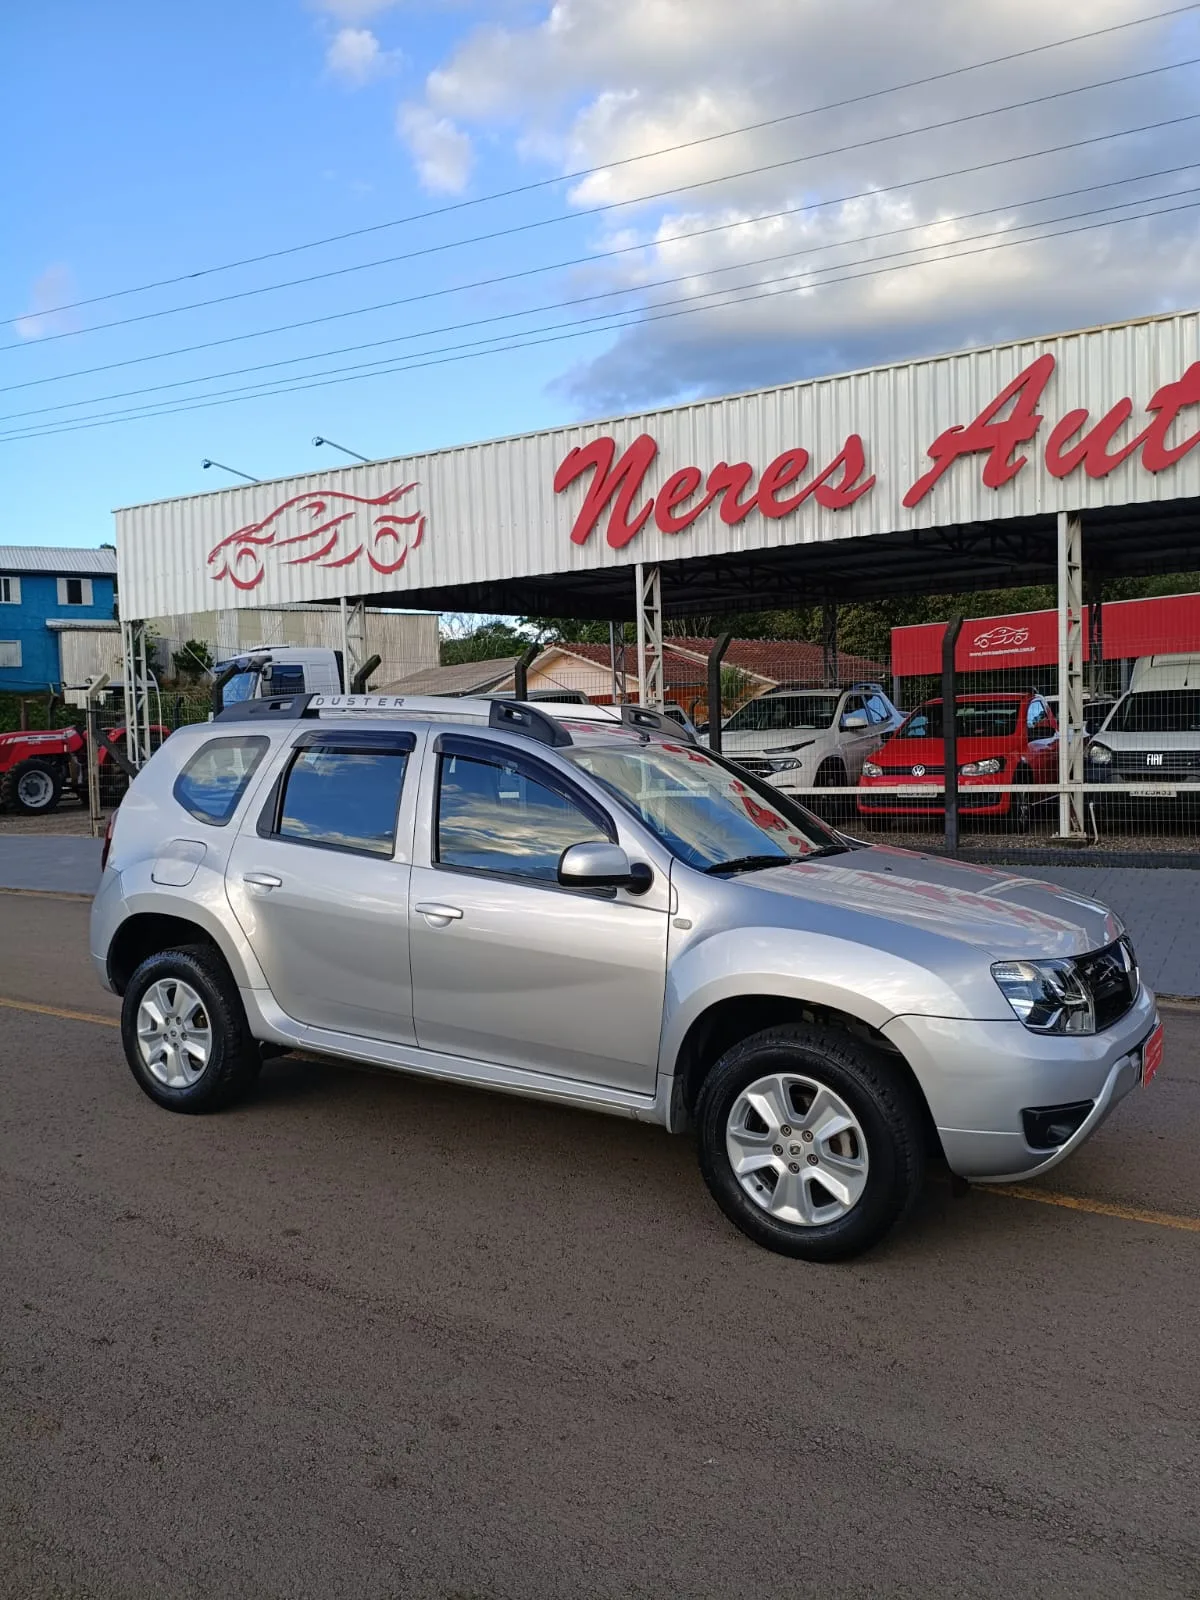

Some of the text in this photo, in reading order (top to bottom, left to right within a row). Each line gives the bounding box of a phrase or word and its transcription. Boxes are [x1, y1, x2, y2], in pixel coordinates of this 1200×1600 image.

[553, 434, 876, 548] Neres
[315, 697, 405, 707] DUSTER
[1146, 753, 1164, 766] FIAT
